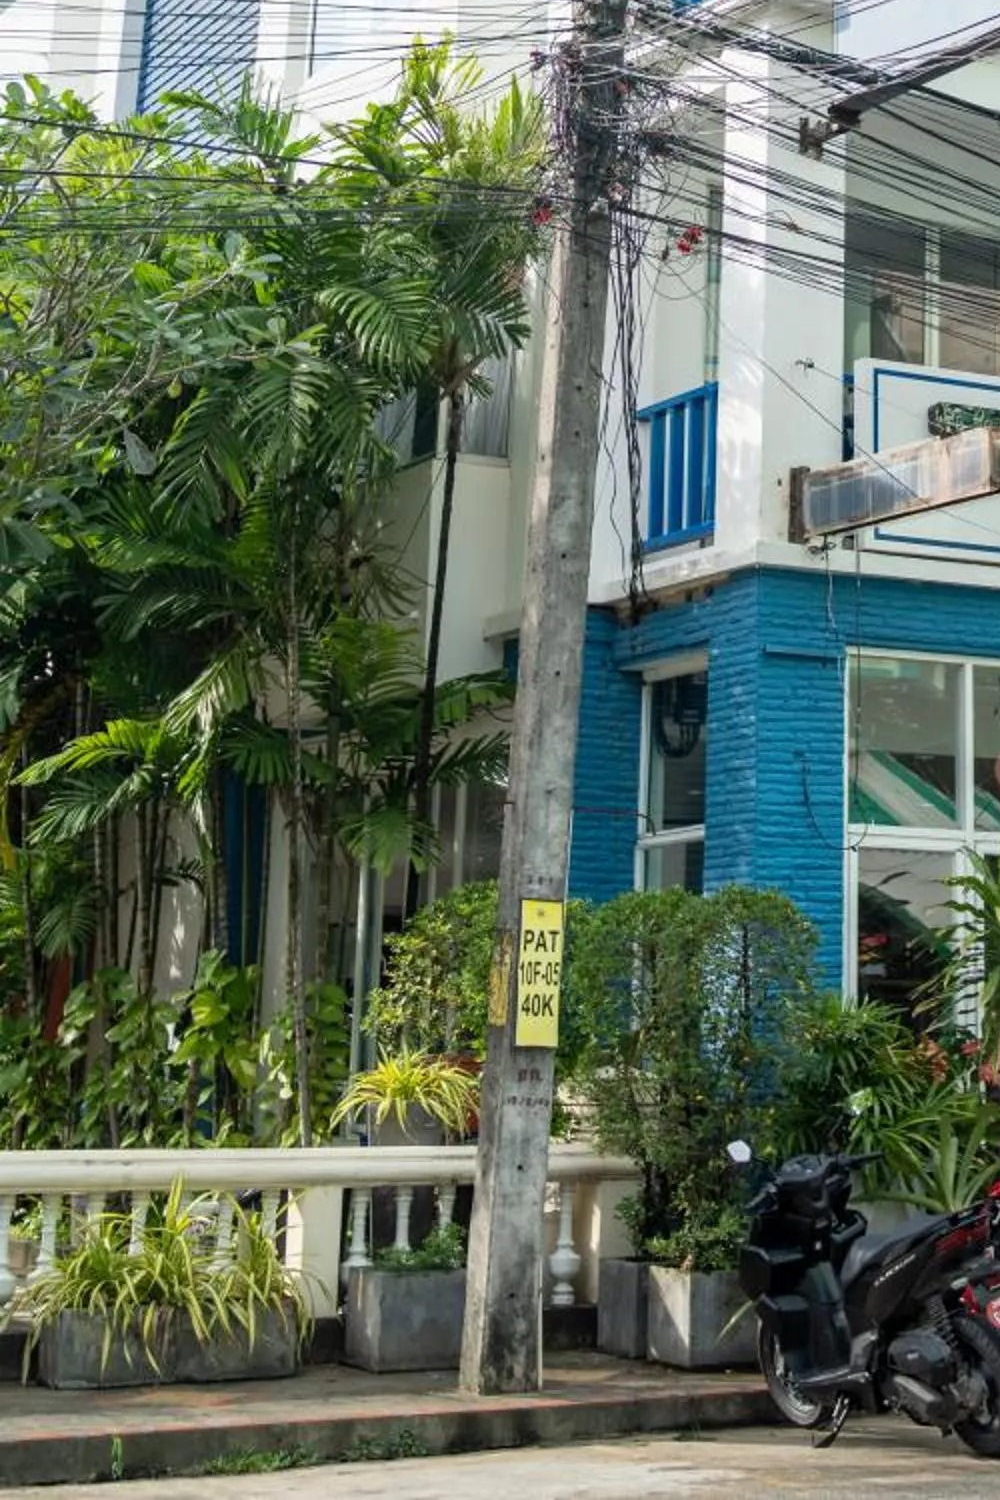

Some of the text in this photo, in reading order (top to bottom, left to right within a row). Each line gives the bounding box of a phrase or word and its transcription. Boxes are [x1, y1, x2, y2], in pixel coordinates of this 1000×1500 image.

[523, 929, 560, 953] PAT
[520, 961, 560, 986] 10F-05
[521, 993, 554, 1017] 40K
